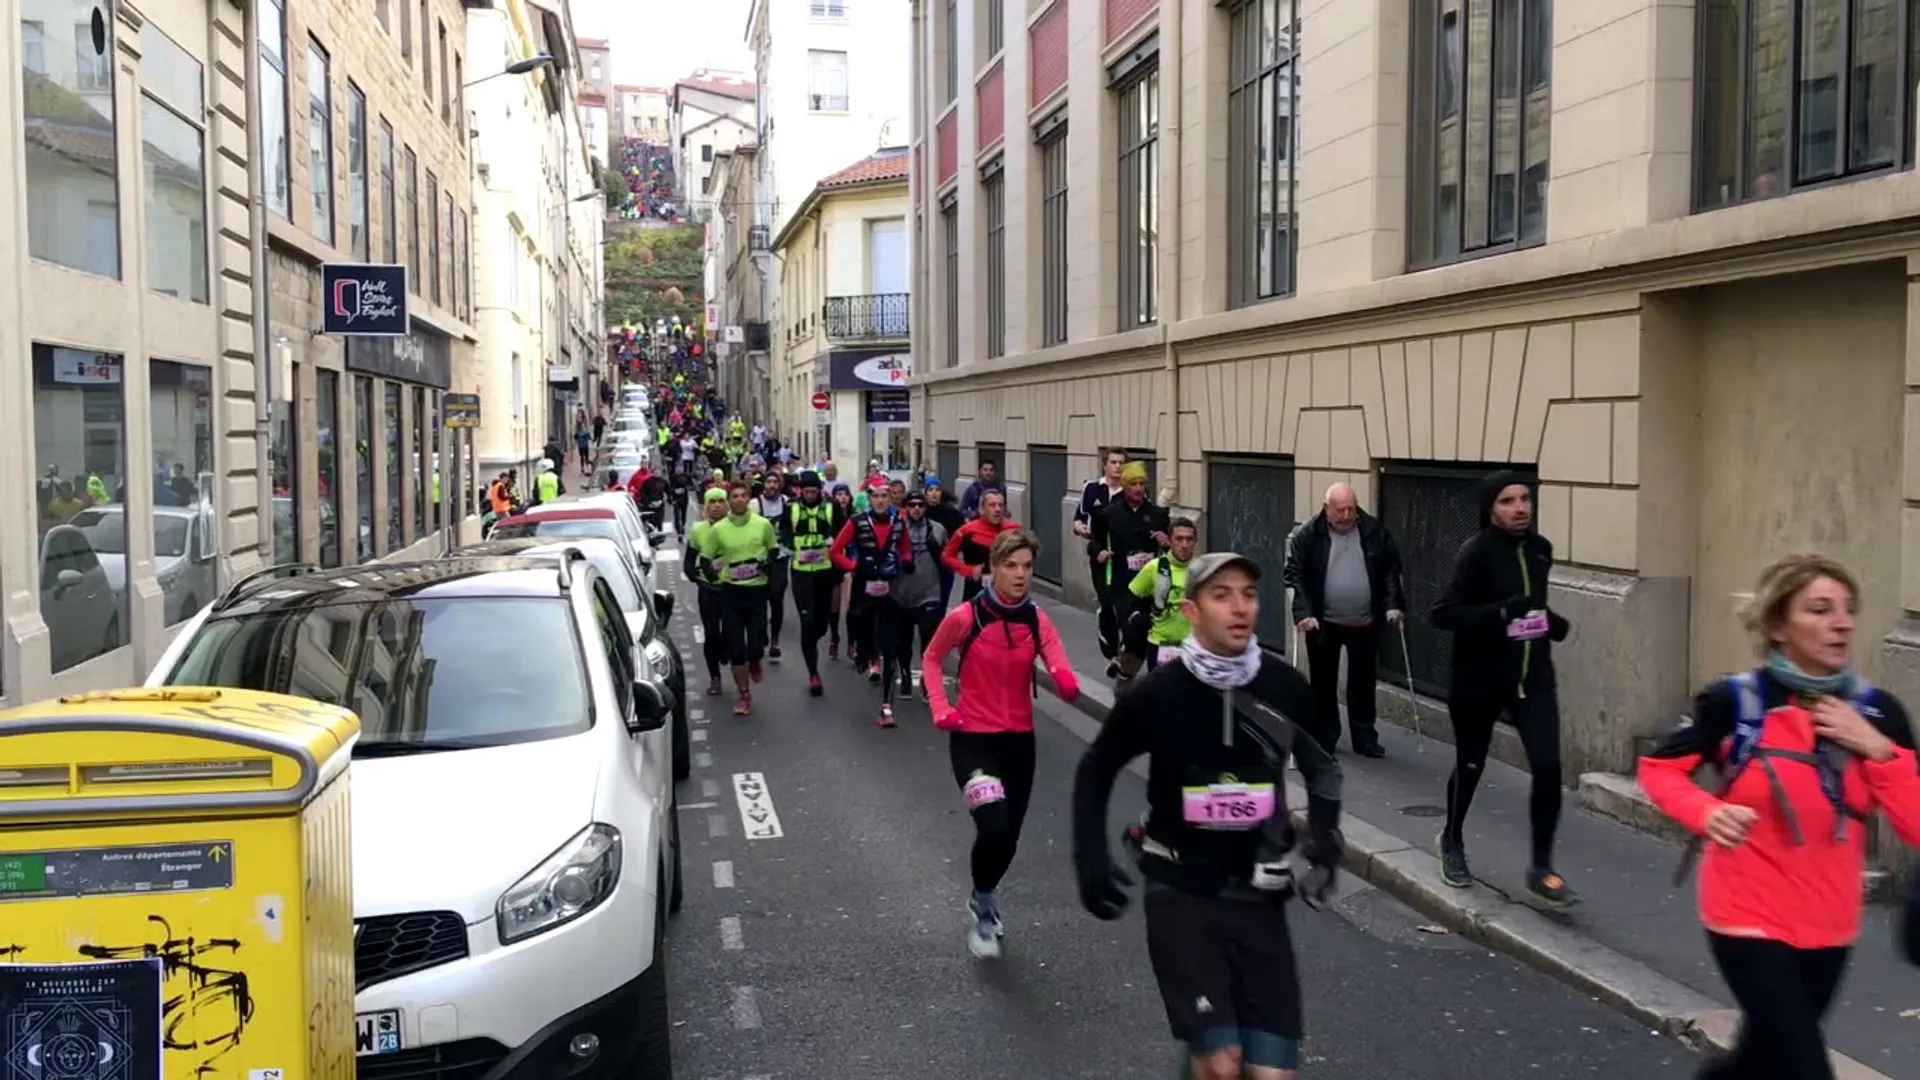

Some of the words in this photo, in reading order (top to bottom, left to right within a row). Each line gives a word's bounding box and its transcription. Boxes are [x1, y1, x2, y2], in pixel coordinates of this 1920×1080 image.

[361, 279, 388, 293] Wall
[361, 304, 397, 320] English
[1203, 801, 1257, 819] 1766
[101, 853, 134, 862] Autres
[135, 849, 203, 861] départements
[160, 862, 203, 873] Étranger
[380, 1034, 397, 1050] 2B
